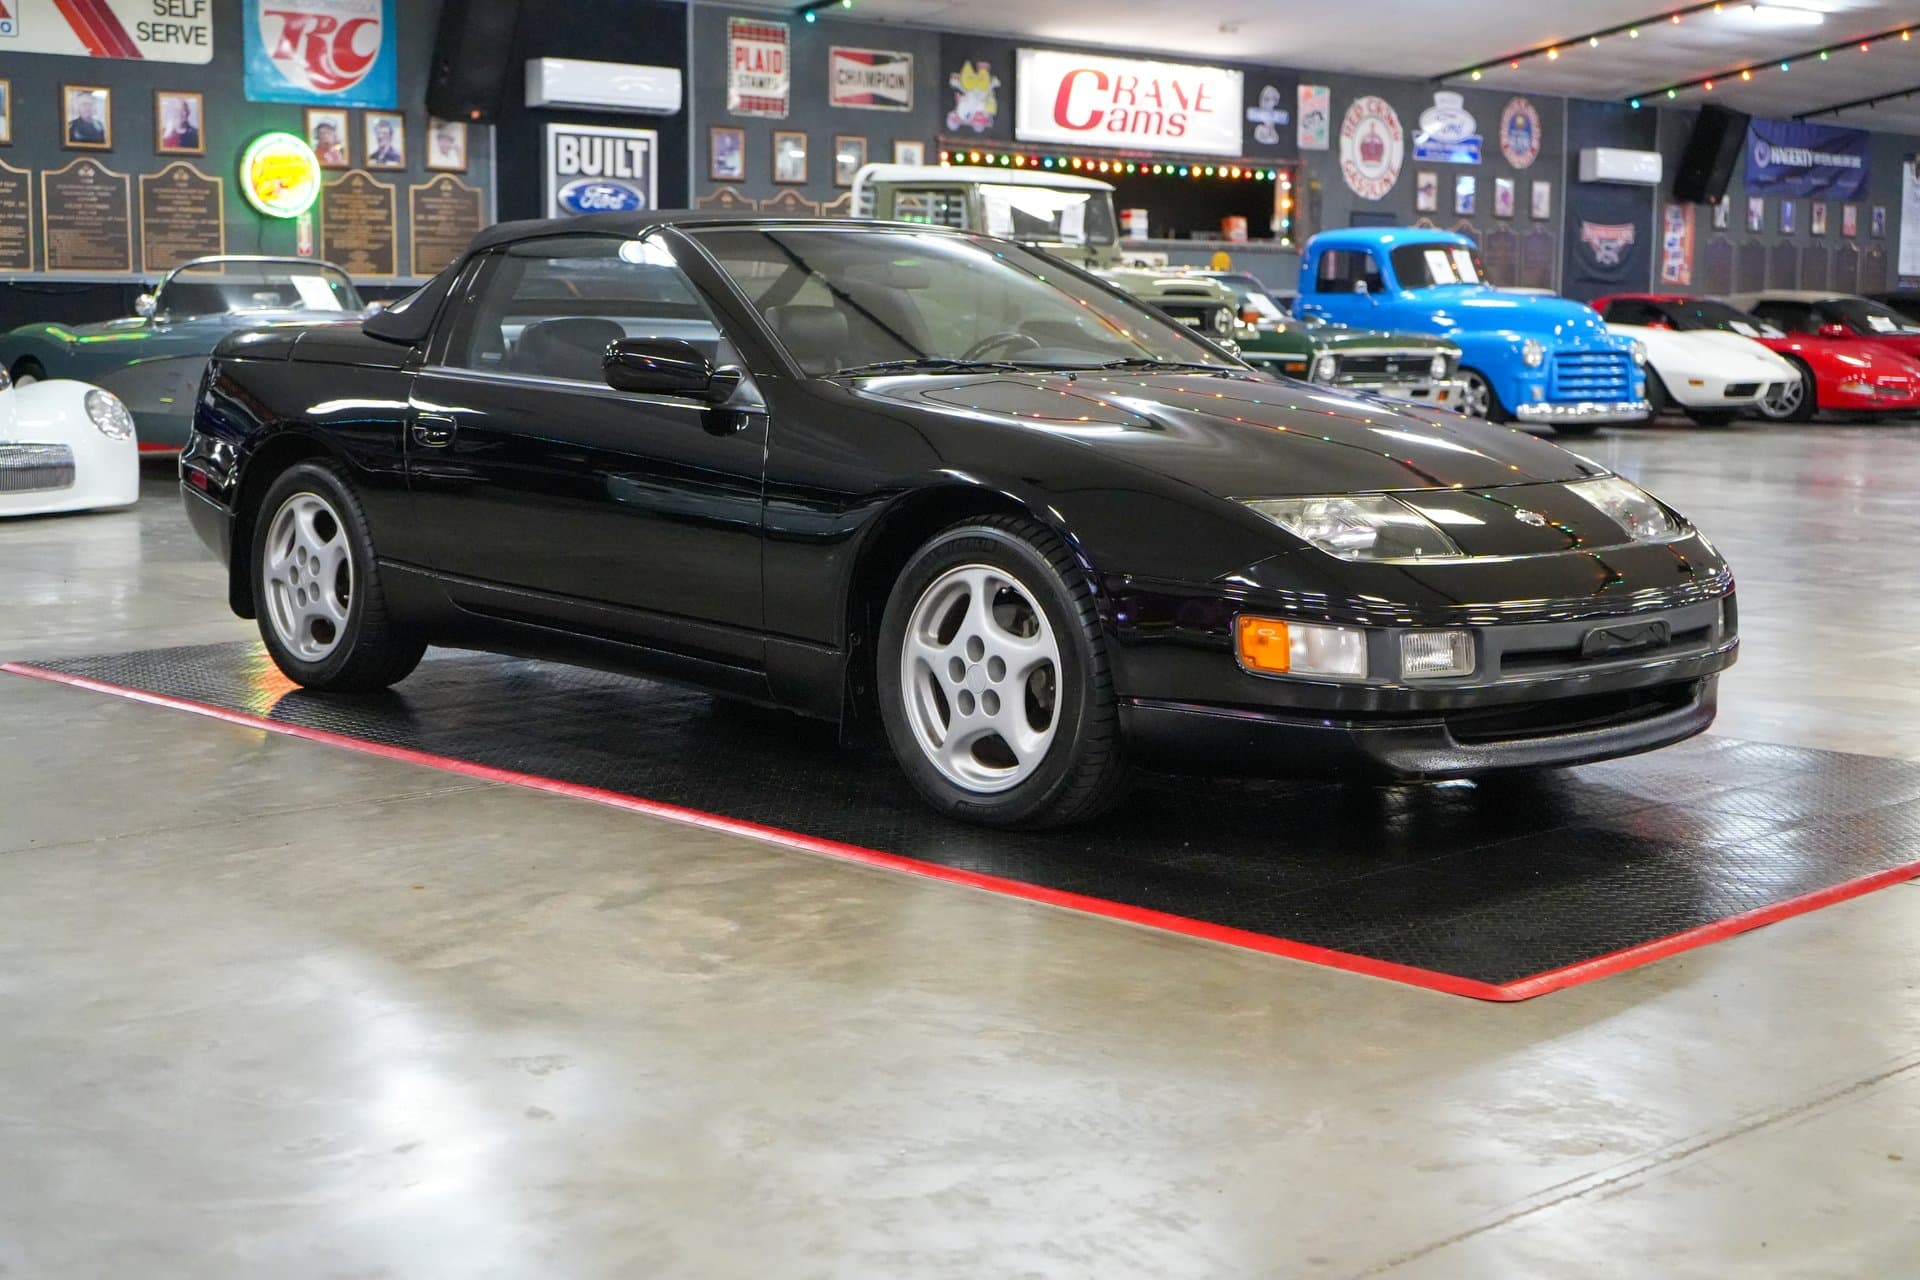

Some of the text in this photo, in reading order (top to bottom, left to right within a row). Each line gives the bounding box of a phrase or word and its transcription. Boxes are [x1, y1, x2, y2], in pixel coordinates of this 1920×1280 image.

[153, 0, 206, 18] SELF
[137, 22, 208, 46] SERVE
[264, 10, 379, 91] RC
[735, 46, 783, 74] PLAID
[838, 69, 906, 90] CHAMPION
[1054, 69, 1214, 131] CRANE
[558, 135, 649, 178] BUILT
